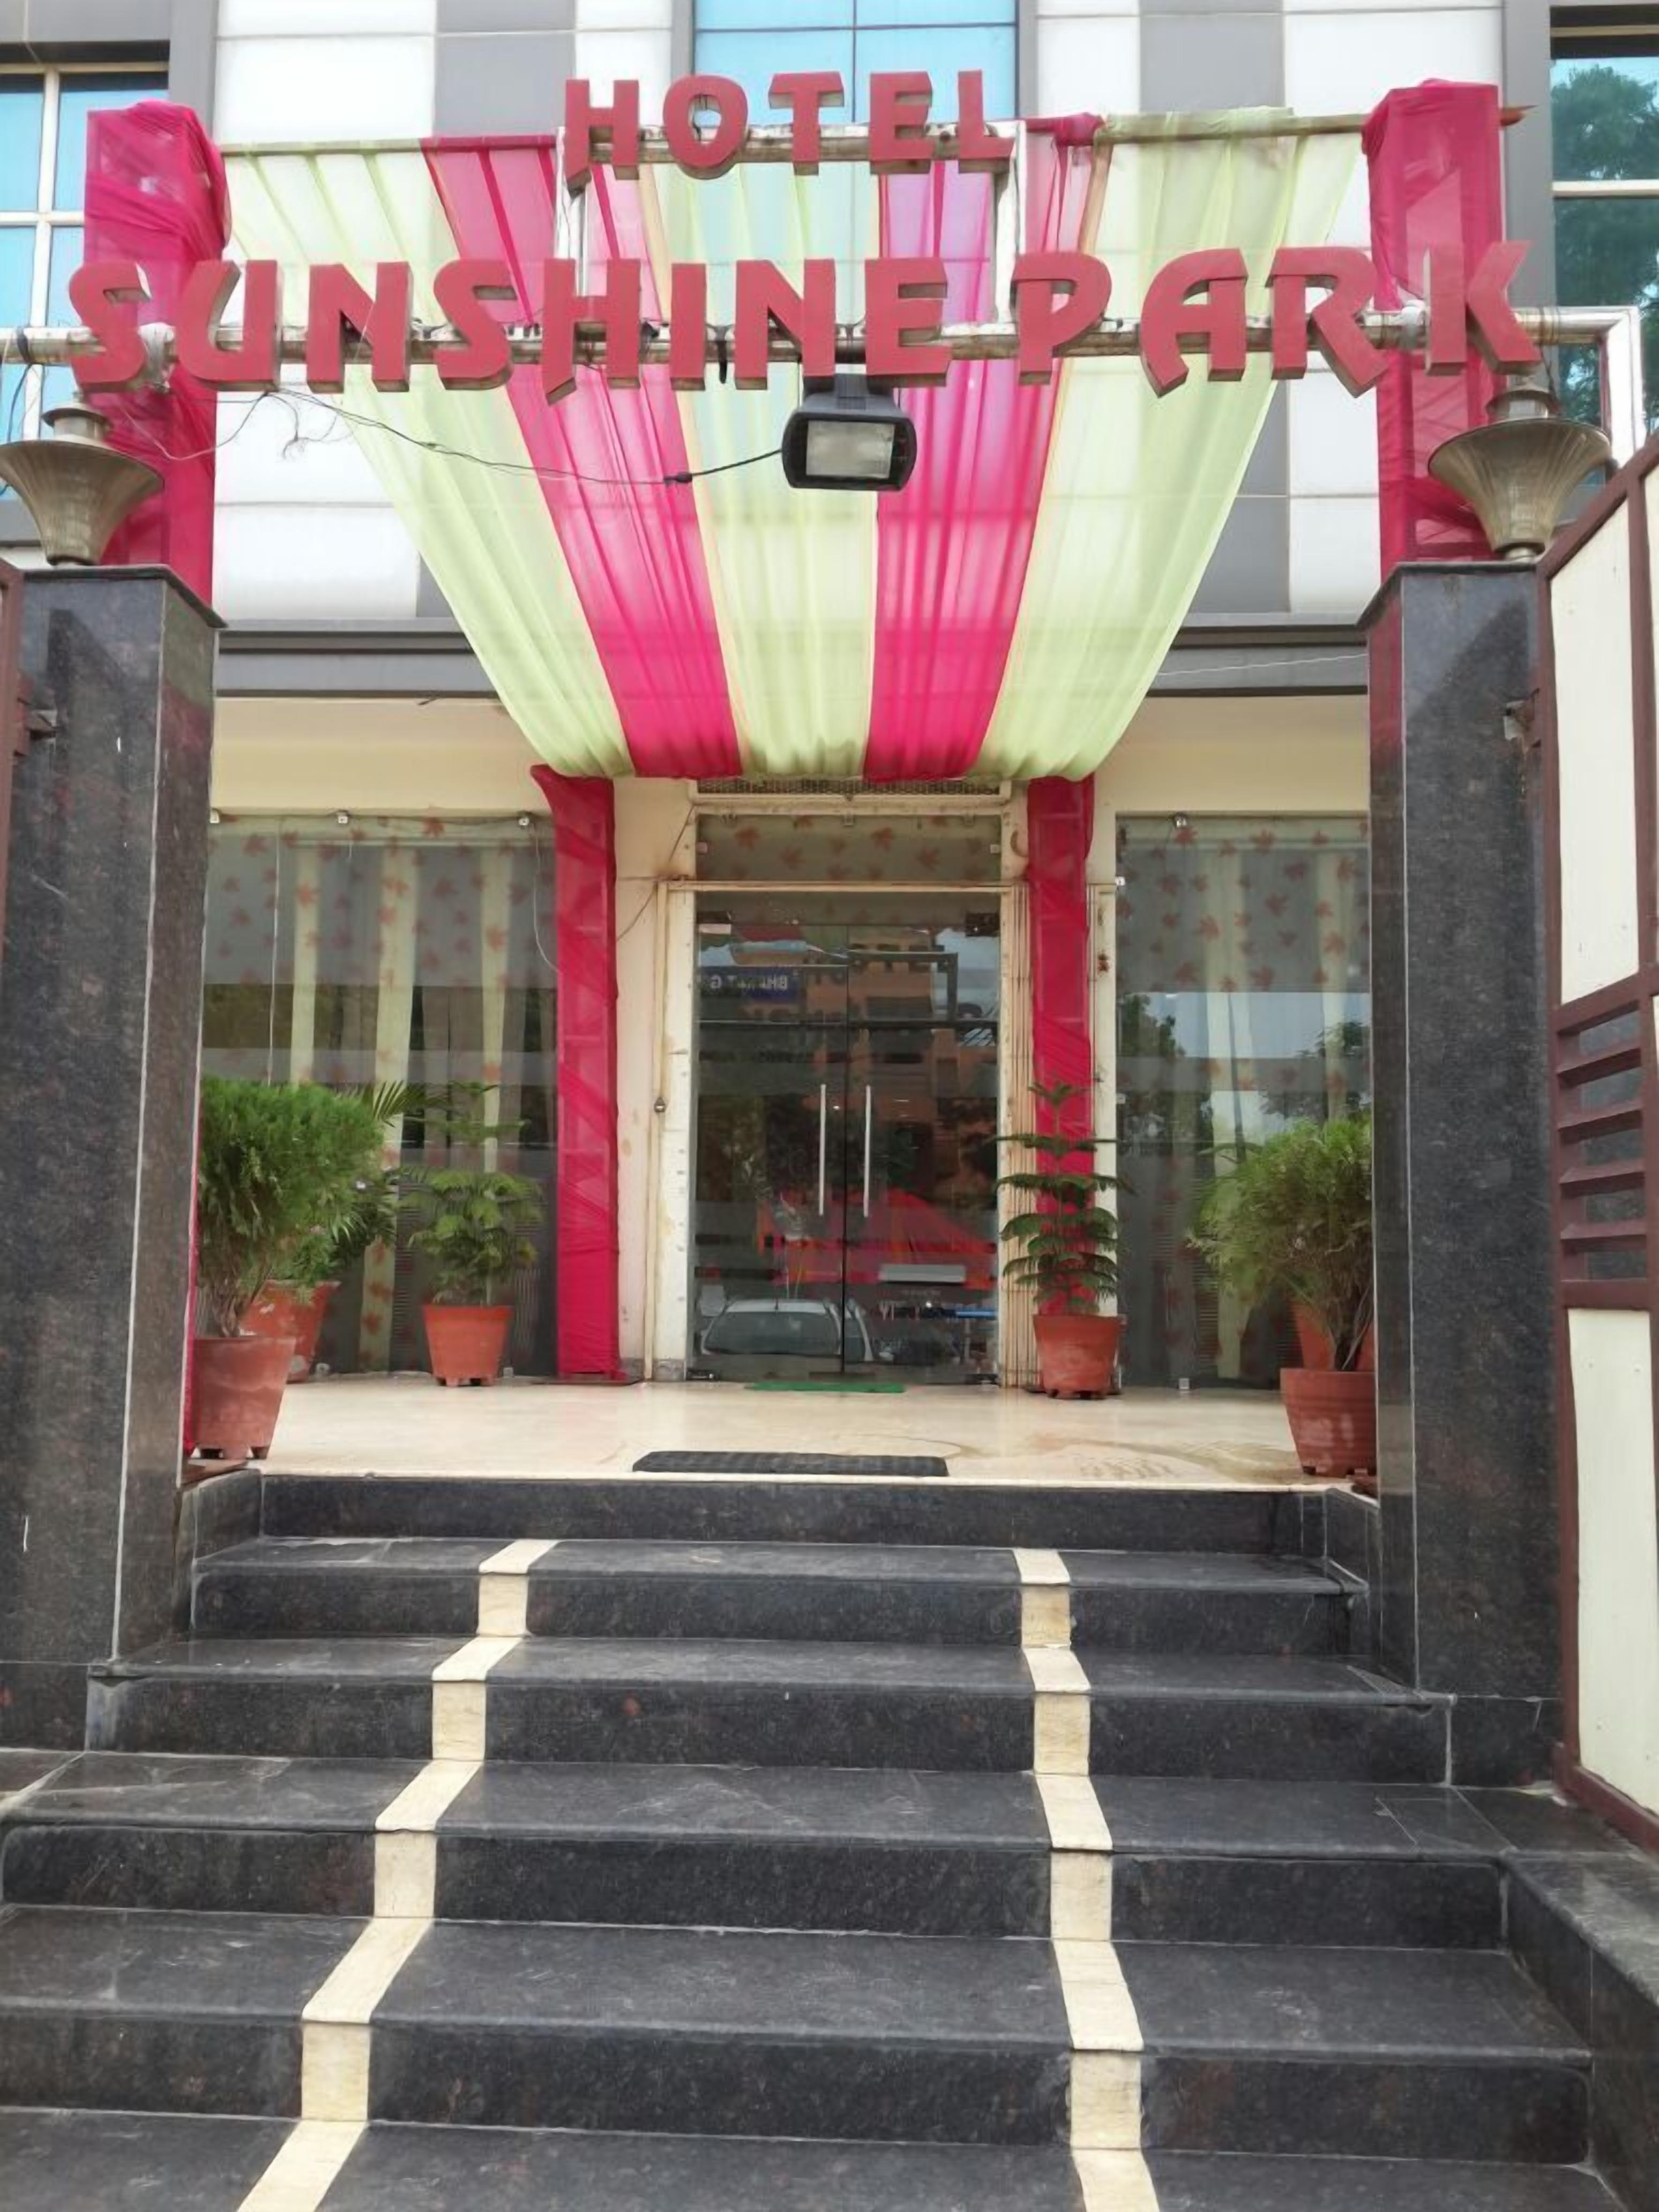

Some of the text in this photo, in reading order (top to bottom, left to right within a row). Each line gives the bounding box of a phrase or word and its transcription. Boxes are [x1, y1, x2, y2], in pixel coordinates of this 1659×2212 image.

[564, 70, 1015, 192] HOTEL
[68, 240, 1542, 401] SUNSHINE PARK
